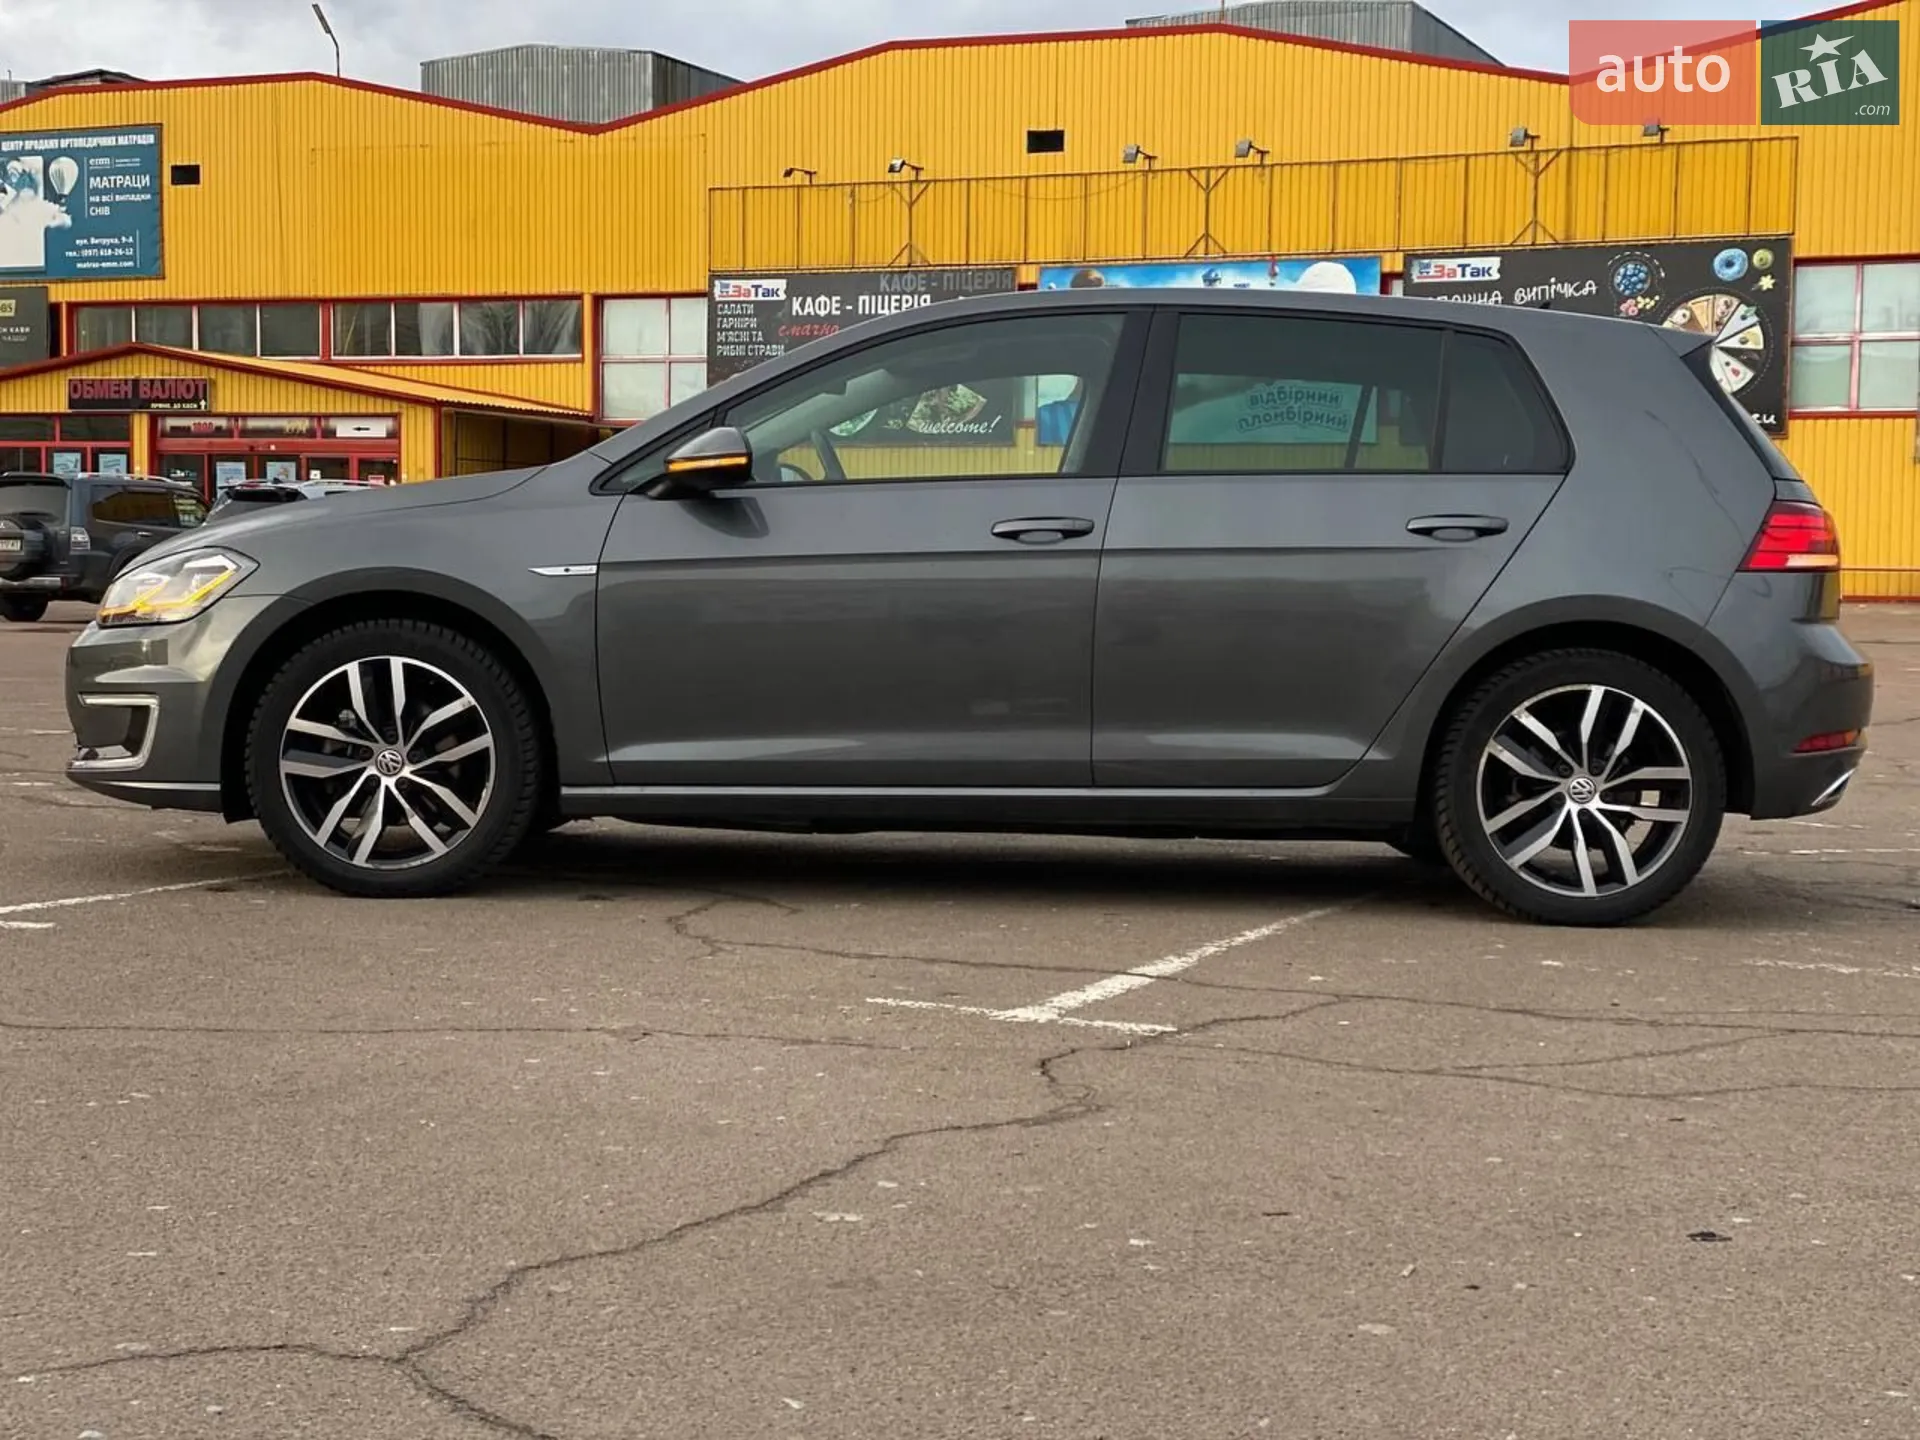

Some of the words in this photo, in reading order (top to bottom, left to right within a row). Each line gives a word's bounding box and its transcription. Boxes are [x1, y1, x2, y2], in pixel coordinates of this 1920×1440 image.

[89, 174, 150, 190] МАТРАЦИ
[89, 205, 111, 216] СНІВ
[1433, 263, 1493, 279] ЗаТак
[879, 274, 927, 292] КАФЕ
[943, 270, 1012, 292] ПІЦЕРІЯ
[731, 284, 780, 298] ЗаТак
[1514, 277, 1598, 305] ВИПІЧКА
[717, 303, 754, 315] САЛАТИ
[792, 295, 841, 317] КАФЕ
[717, 317, 757, 329] ГАРНІРИ
[752, 331, 764, 342] ТА
[717, 345, 746, 357] РИБНІ
[70, 380, 133, 399] ОБМЕН
[139, 378, 206, 399] ВАЛЮТ
[918, 414, 1003, 434] welcome!
